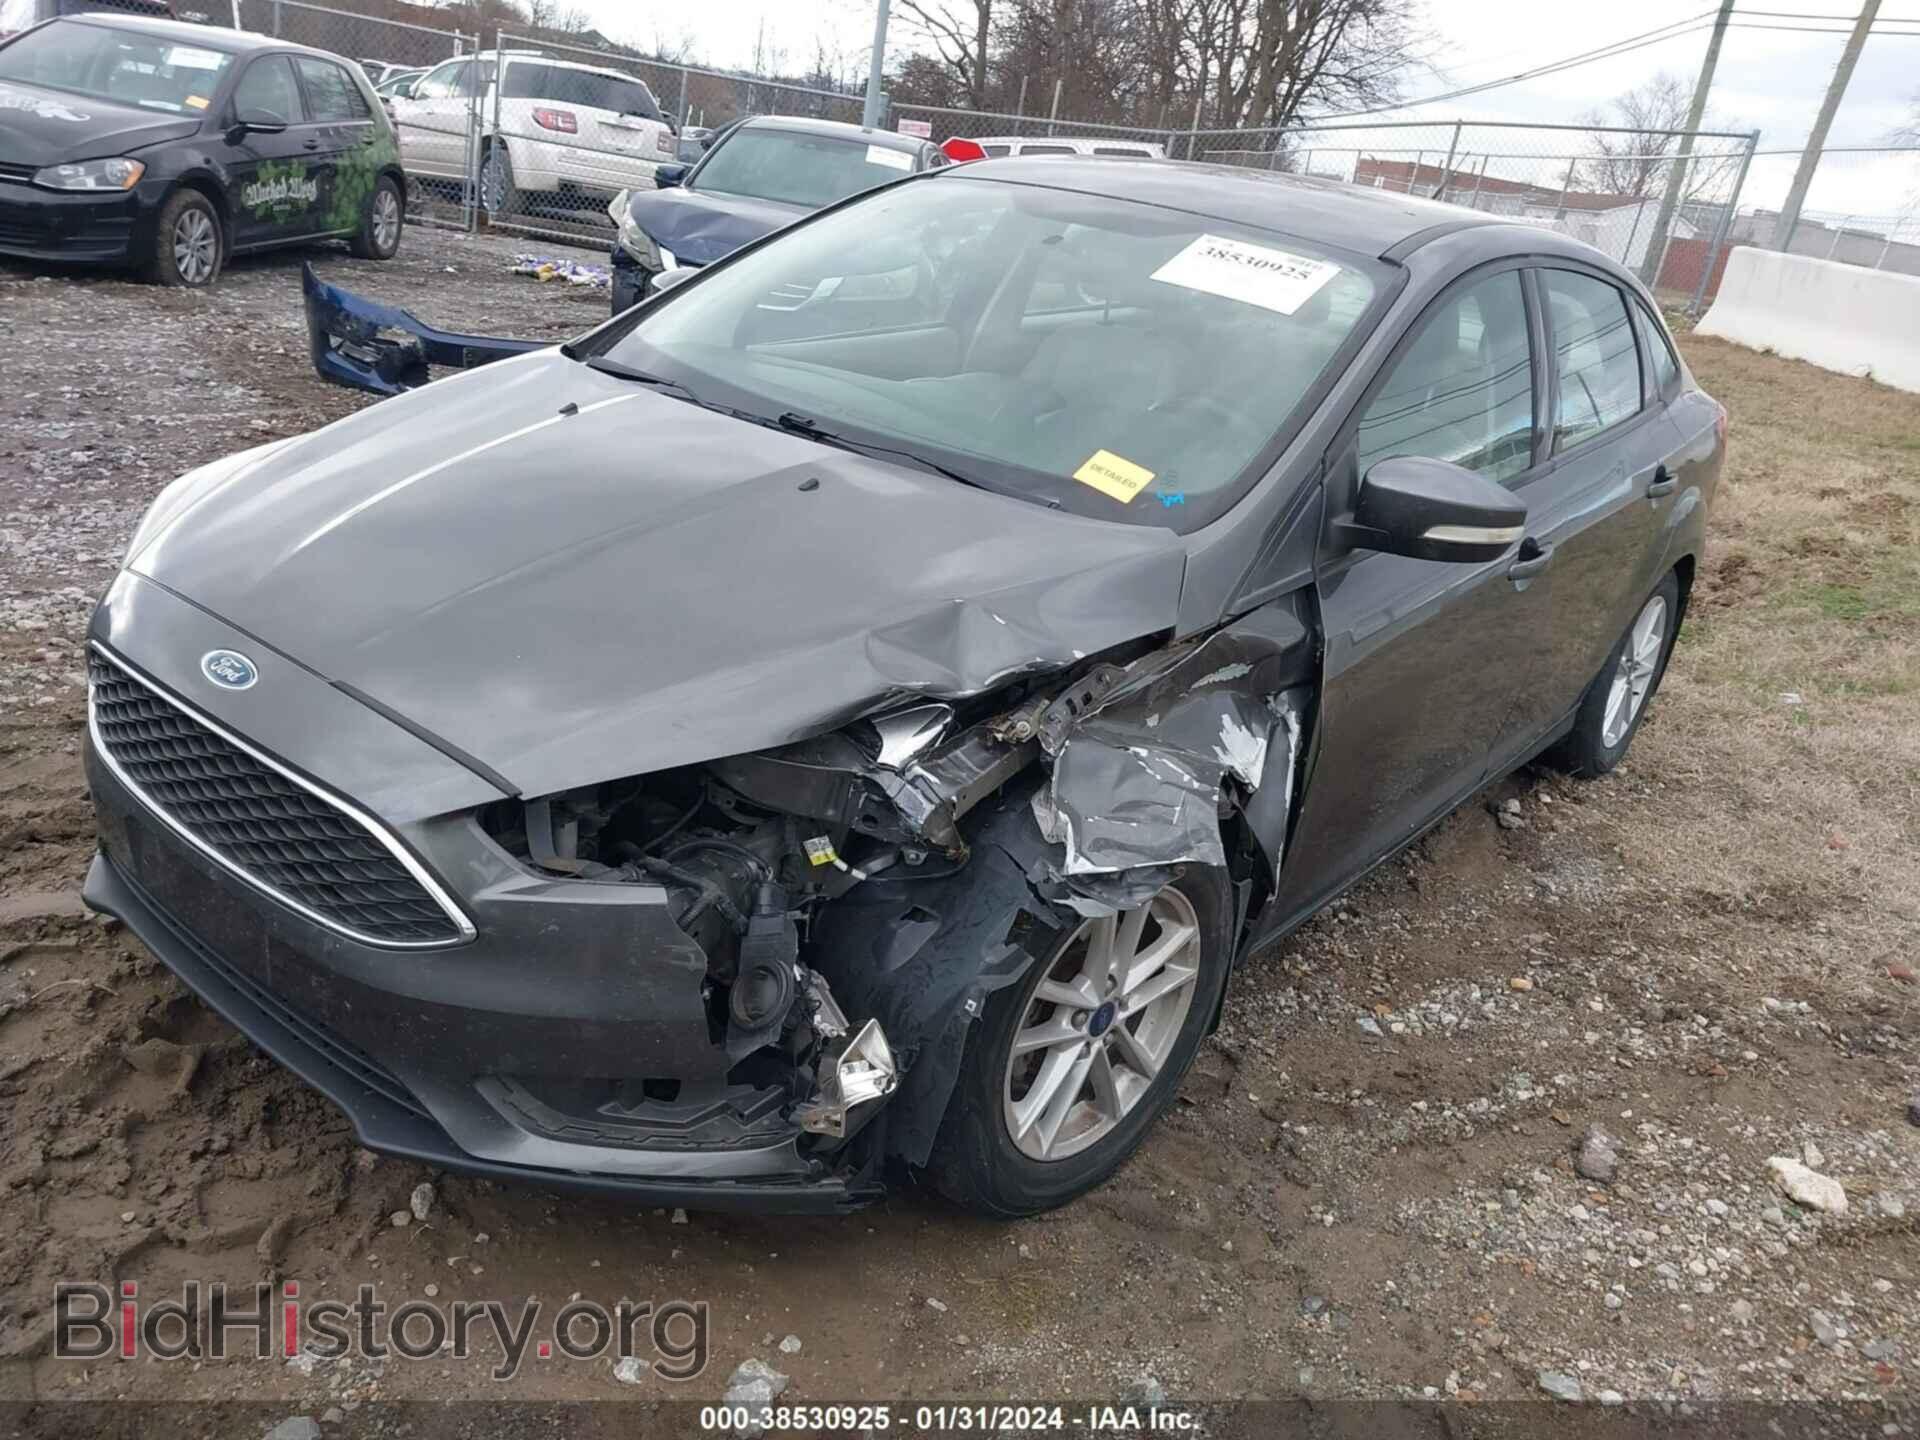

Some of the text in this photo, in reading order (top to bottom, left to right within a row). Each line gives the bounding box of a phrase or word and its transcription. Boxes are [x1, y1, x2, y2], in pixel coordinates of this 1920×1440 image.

[1199, 247, 1312, 280] 38530925
[1089, 463, 1138, 489] DETAILED
[210, 656, 246, 682] Ford
